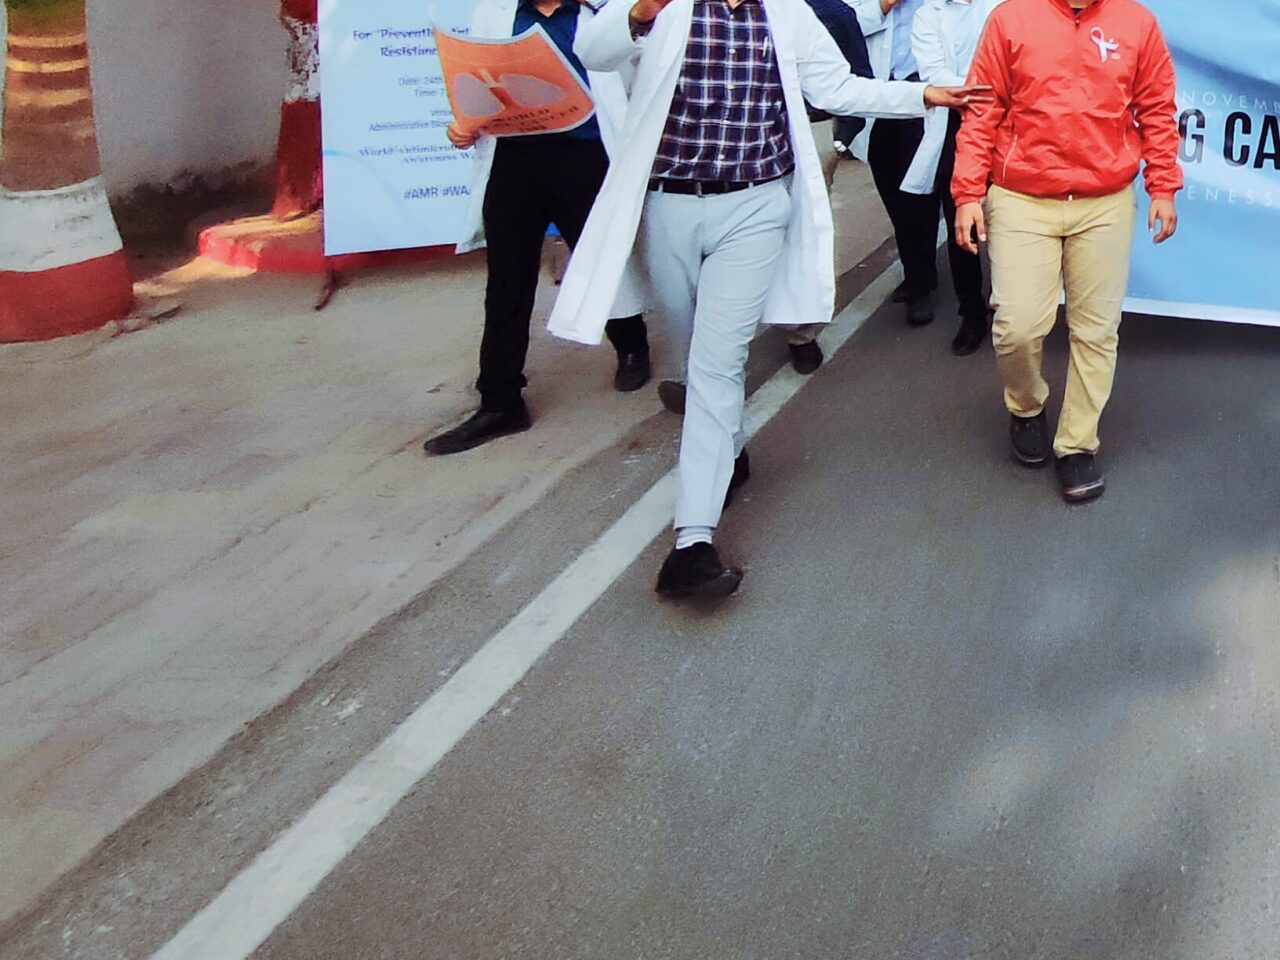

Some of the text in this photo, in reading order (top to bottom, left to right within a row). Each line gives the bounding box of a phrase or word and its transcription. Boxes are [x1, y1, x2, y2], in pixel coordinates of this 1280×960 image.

[353, 28, 433, 41] For Preventi
[404, 185, 470, 200] #AMR #WA
[1187, 188, 1273, 207] ENESS
